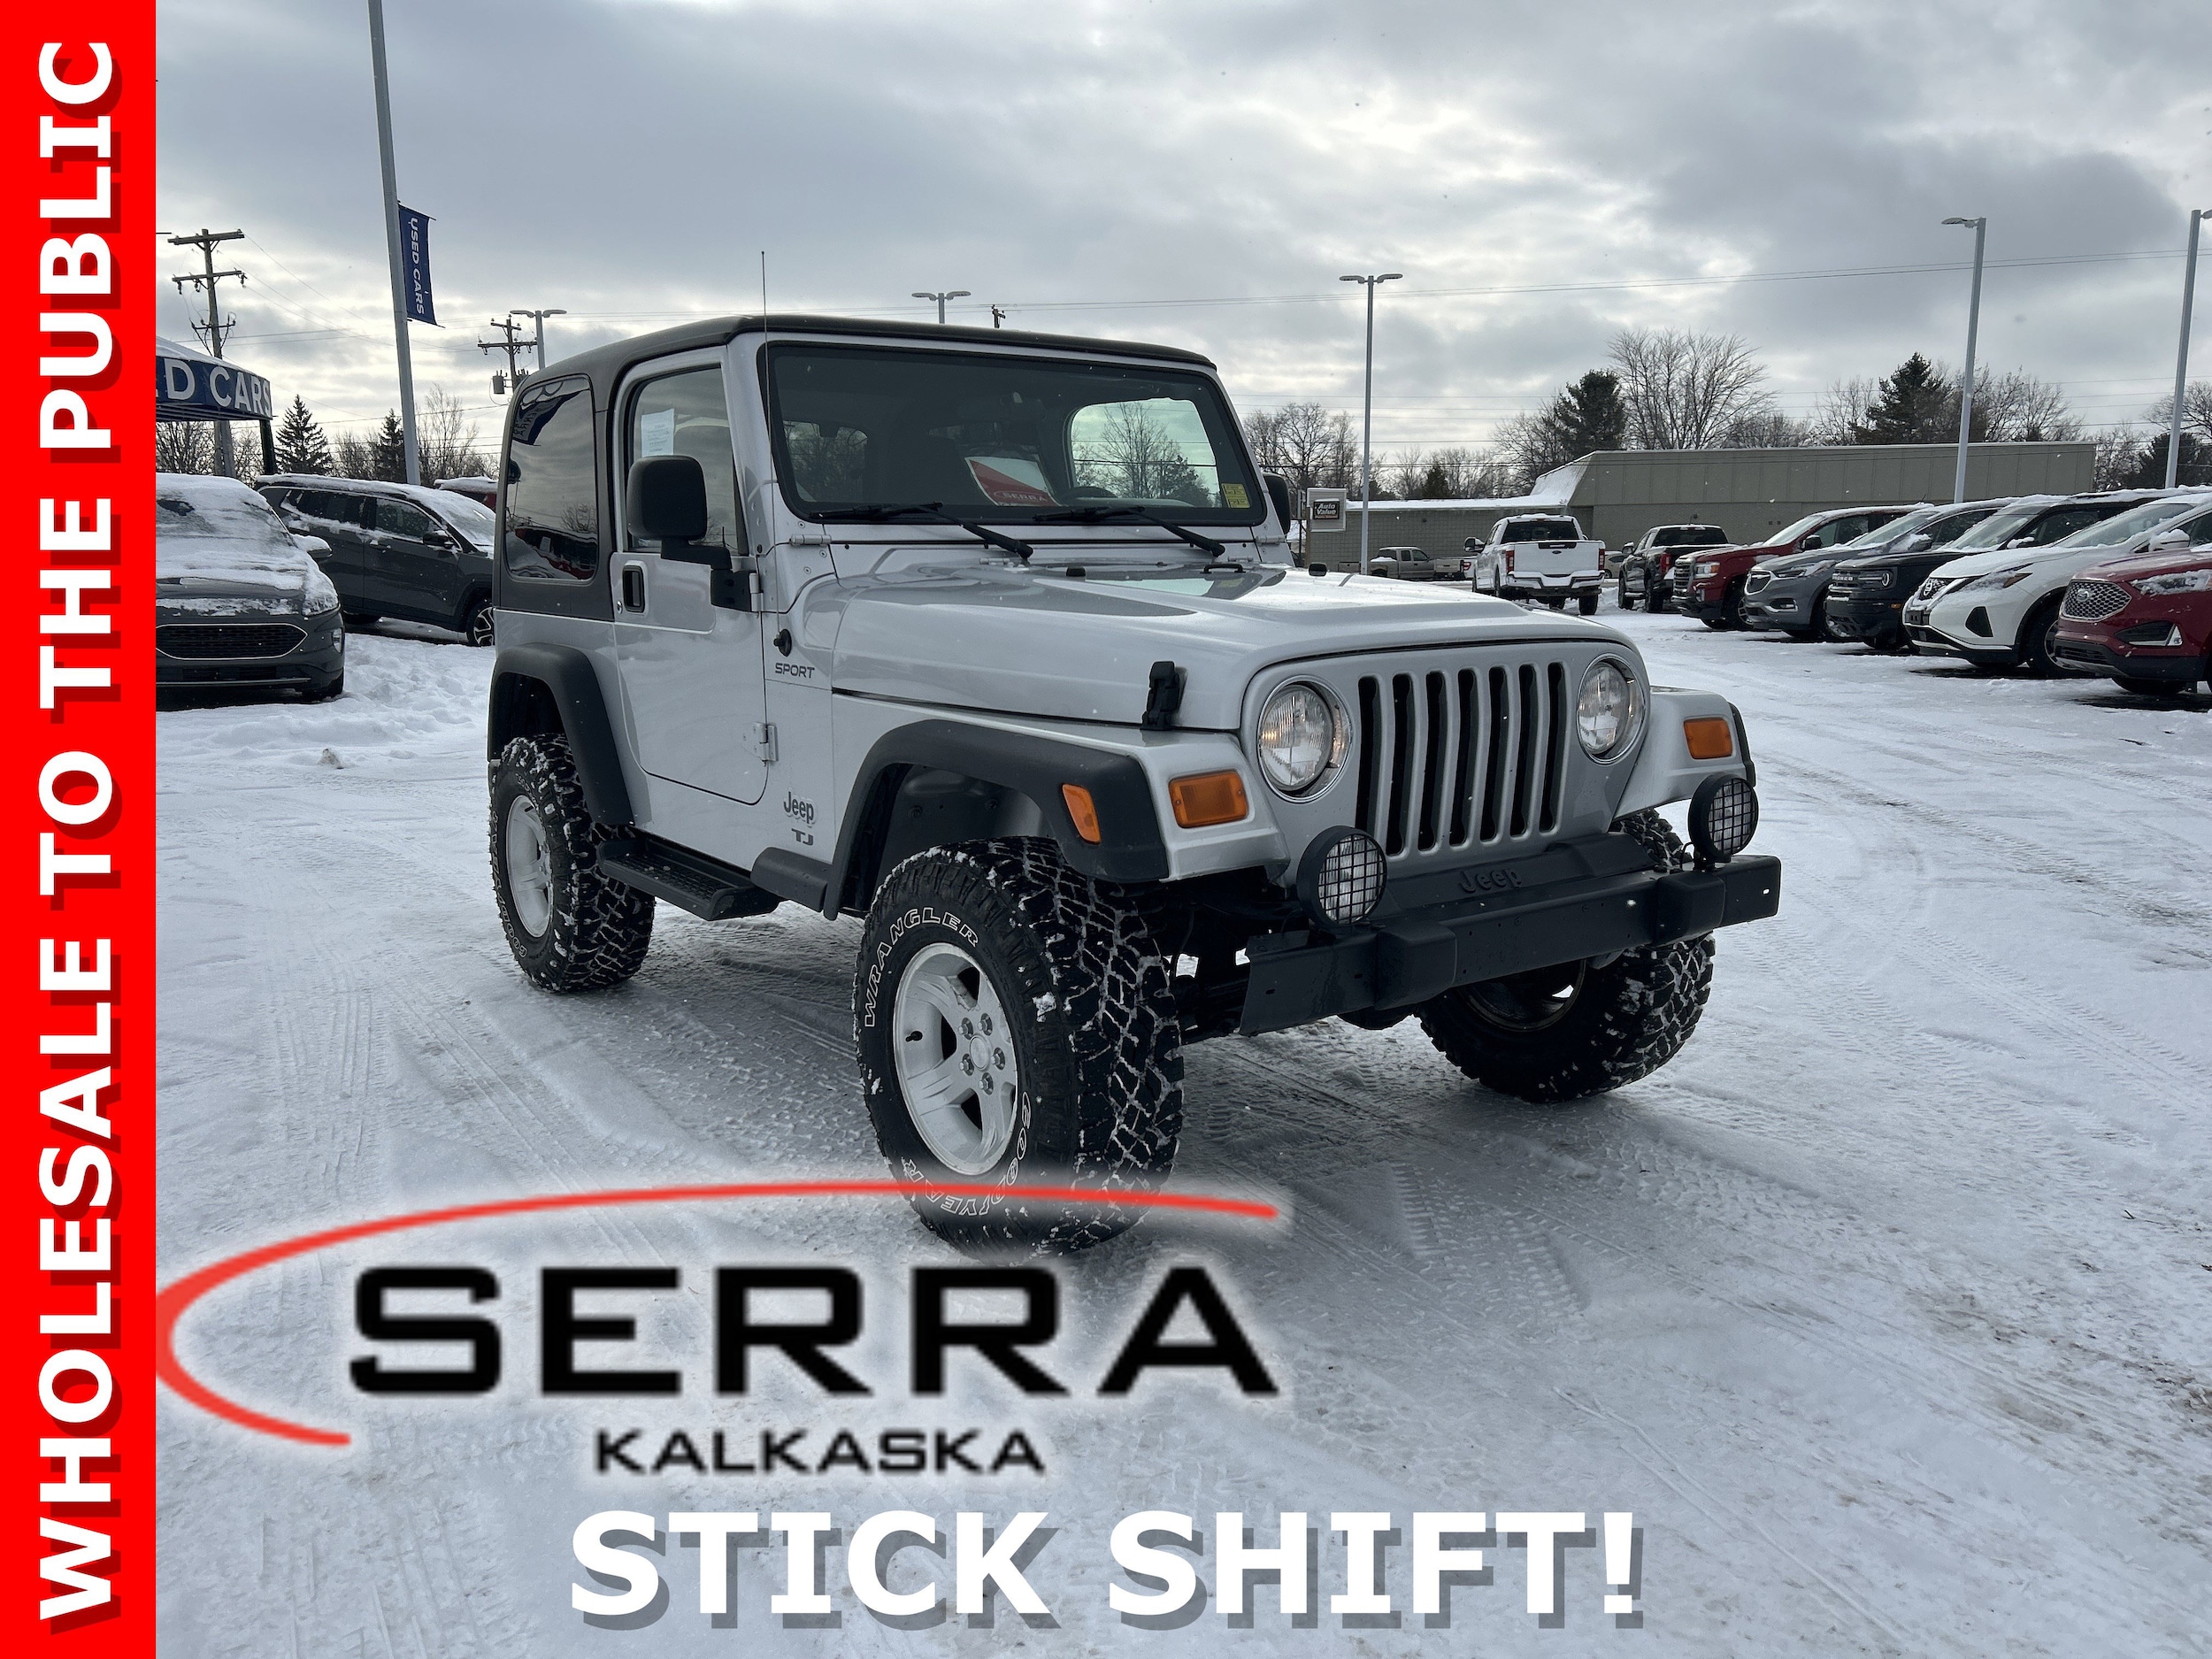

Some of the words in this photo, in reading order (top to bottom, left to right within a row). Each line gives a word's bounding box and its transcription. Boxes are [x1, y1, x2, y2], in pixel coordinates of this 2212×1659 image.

[411, 217, 419, 265] USED
[413, 268, 425, 315] CARS
[209, 365, 272, 418] CARS
[775, 662, 816, 679] SPORT
[783, 790, 814, 825] Jeep
[791, 827, 814, 846] TJ
[1457, 869, 1523, 894] Jeep
[864, 907, 979, 1027] WRANGLER
[902, 1091, 1032, 1217] GOODYEAR
